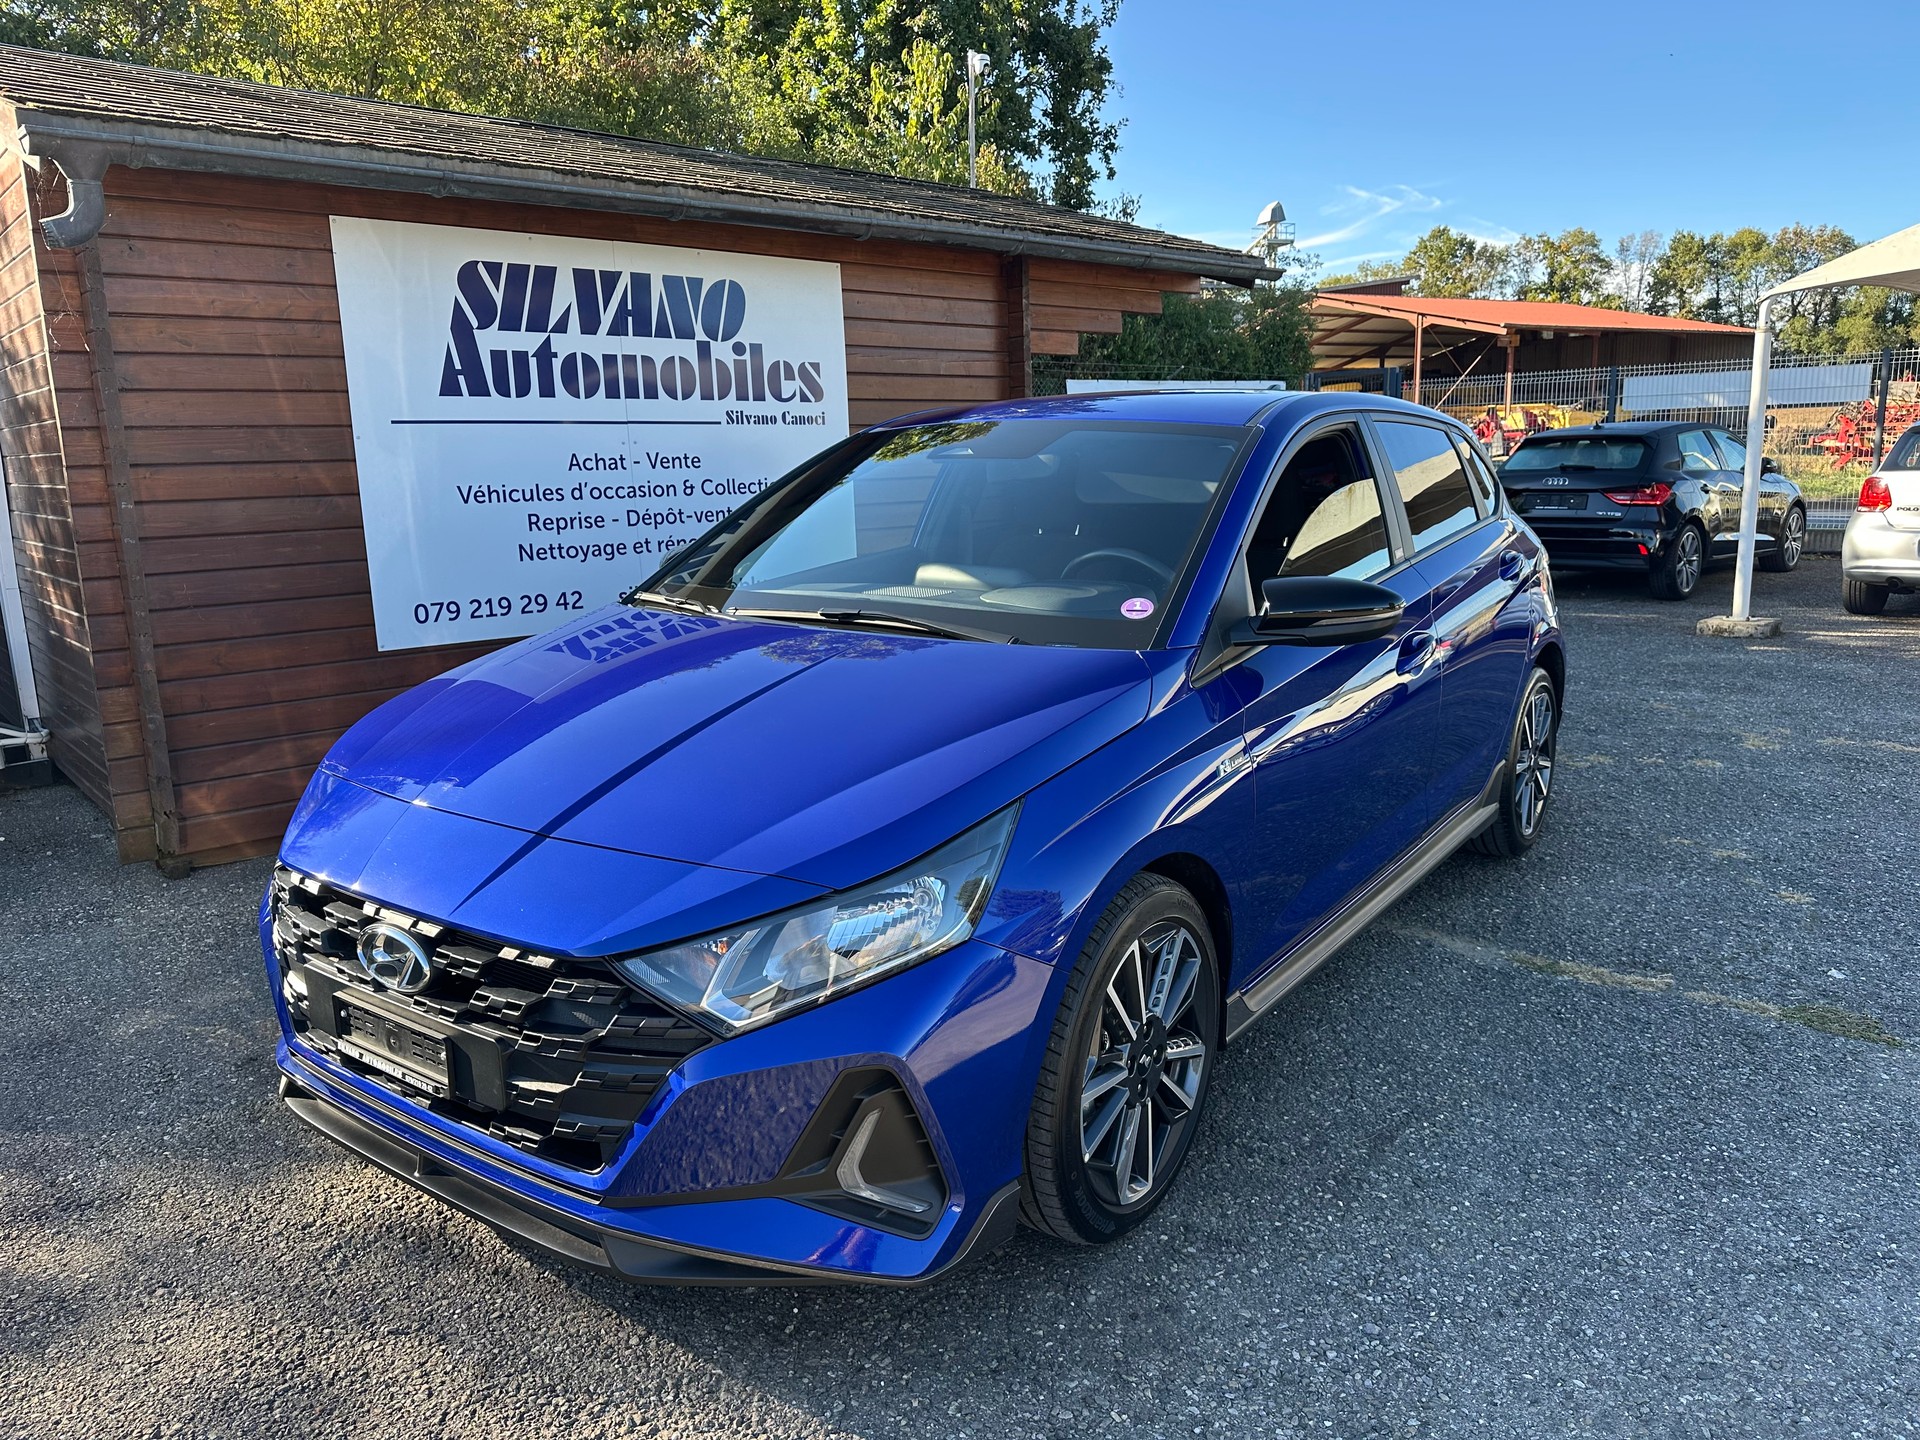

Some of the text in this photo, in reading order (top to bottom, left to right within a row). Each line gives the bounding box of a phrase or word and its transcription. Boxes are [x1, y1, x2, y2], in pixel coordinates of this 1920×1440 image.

[457, 260, 746, 342] SILVANO
[439, 296, 824, 403] Automobiles
[725, 410, 826, 426] Silvano Canoci
[568, 453, 627, 471] Achat
[646, 452, 701, 469] Vente
[456, 483, 565, 504] Véhicules
[683, 479, 695, 496] &
[701, 477, 776, 496] Collecti
[527, 512, 605, 535] Reprise
[518, 541, 627, 563] Nettoyage
[633, 538, 652, 554] et
[414, 590, 584, 624] 079 219 29 42
[1133, 601, 1142, 610] 1
